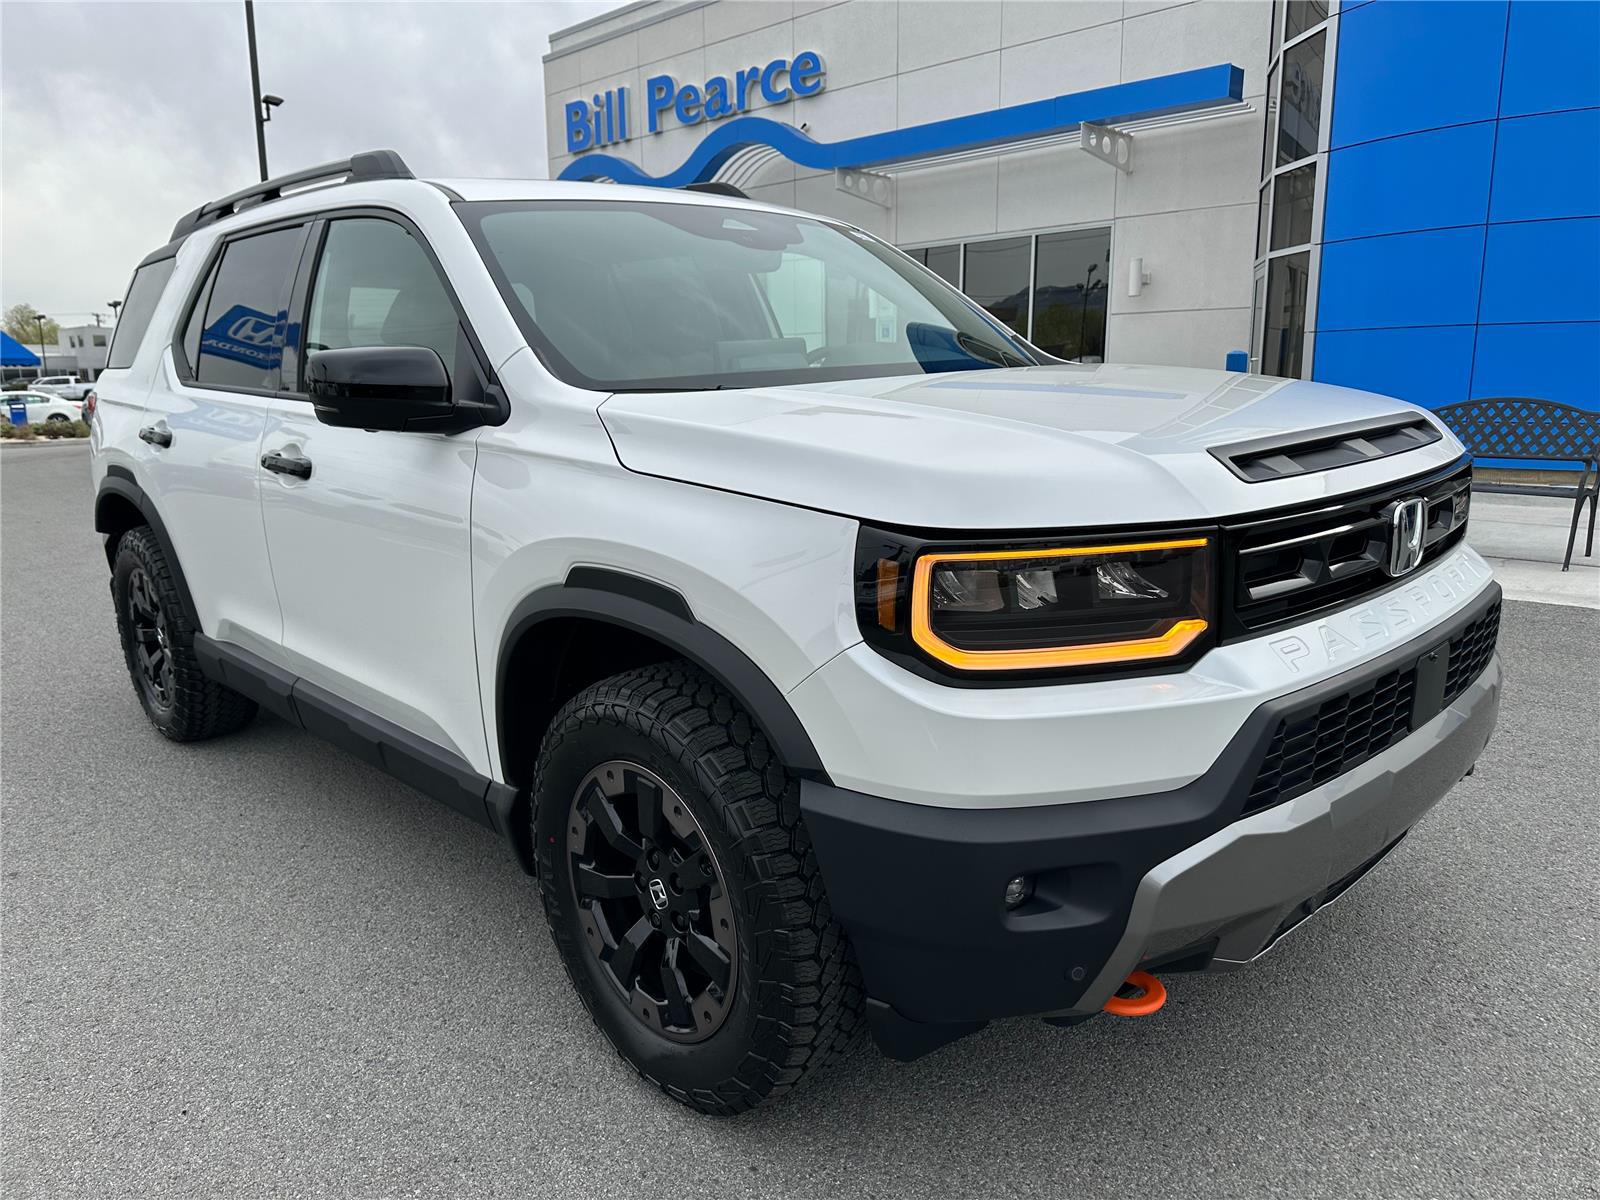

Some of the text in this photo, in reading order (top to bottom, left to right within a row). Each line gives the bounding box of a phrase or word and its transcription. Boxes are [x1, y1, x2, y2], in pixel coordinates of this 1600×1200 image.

[565, 51, 824, 153] Bill Pearce
[1268, 553, 1481, 673] PASSPORT
